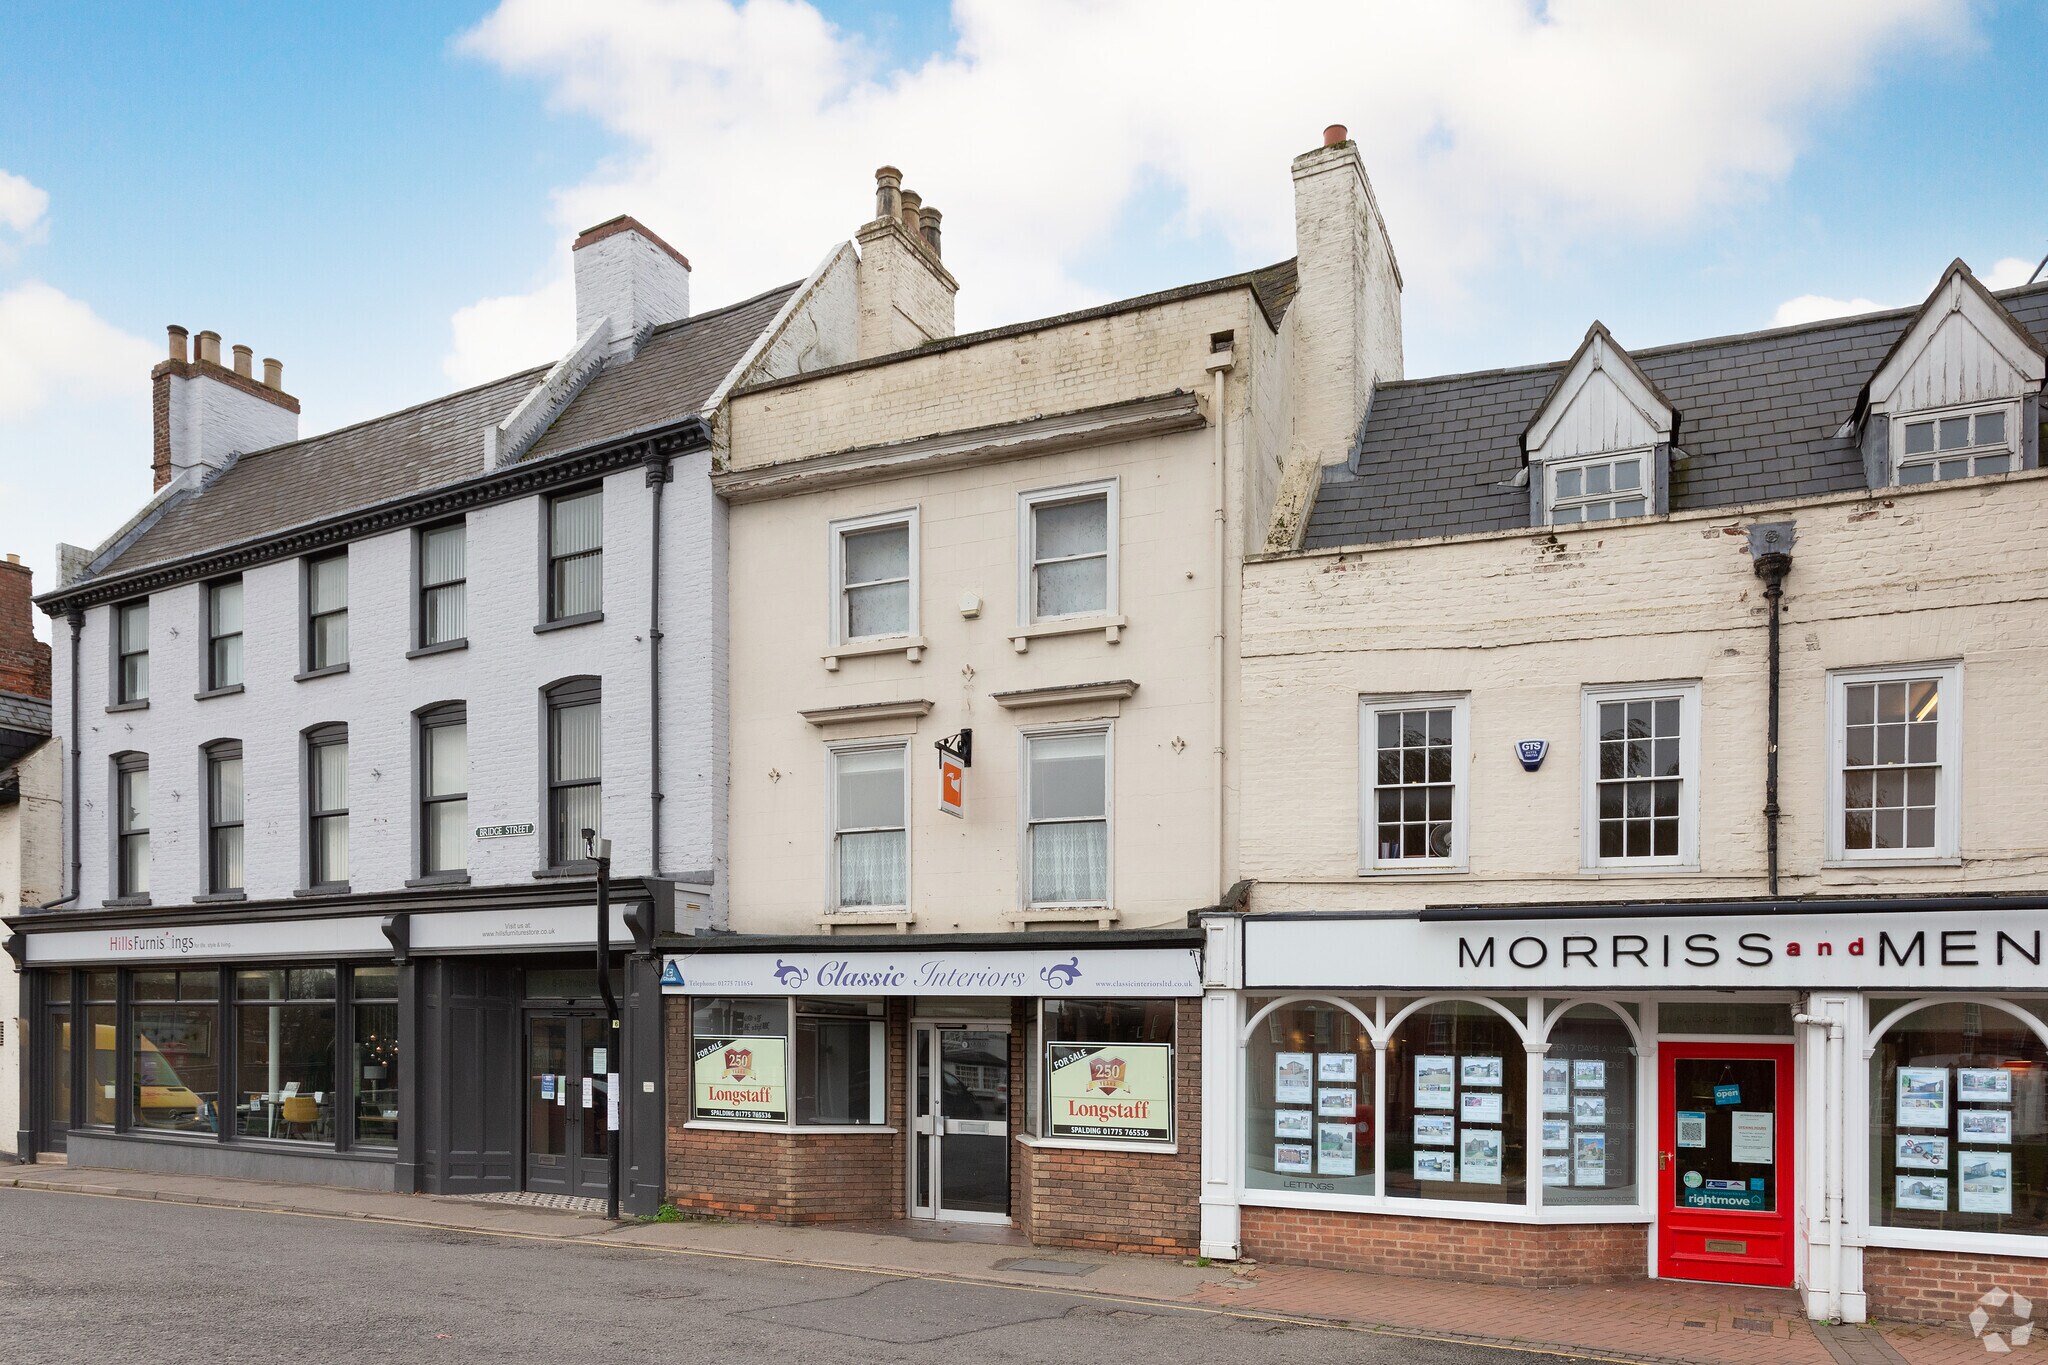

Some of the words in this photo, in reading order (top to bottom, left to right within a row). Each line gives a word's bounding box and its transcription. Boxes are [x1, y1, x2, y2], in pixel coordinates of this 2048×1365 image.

[1521, 741, 1541, 751] GTS
[479, 826, 503, 837] BRIDGE
[505, 824, 530, 835] STREET
[482, 928, 555, 937] www.hillsfurniturestore.co.uk
[1458, 932, 1774, 969] MORRISS
[1786, 938, 1864, 957] and
[1878, 930, 2042, 967] MEN
[817, 960, 908, 988] Classic
[913, 959, 1029, 988] Interiors
[689, 980, 717, 988] Telephone:
[696, 1049, 710, 1059] FOR
[708, 1040, 723, 1053] SALE
[729, 1054, 748, 1067] 250
[1054, 1057, 1071, 1070] FOR
[1069, 1048, 1088, 1063] SALE
[1095, 1064, 1120, 1079] 250
[708, 1086, 772, 1106] Longstaff
[1716, 1090, 1738, 1099] open
[711, 1109, 735, 1117] SPALDING
[1069, 1100, 1149, 1122] Longstaff
[1071, 1126, 1101, 1135] SPALDING
[1103, 1128, 1123, 1136] 01775
[1125, 1129, 1149, 1137] 765536
[1905, 1139, 1940, 1165] SOLD
[1283, 1180, 1335, 1191] LETTINGS
[1688, 1193, 1751, 1206] rightmove
